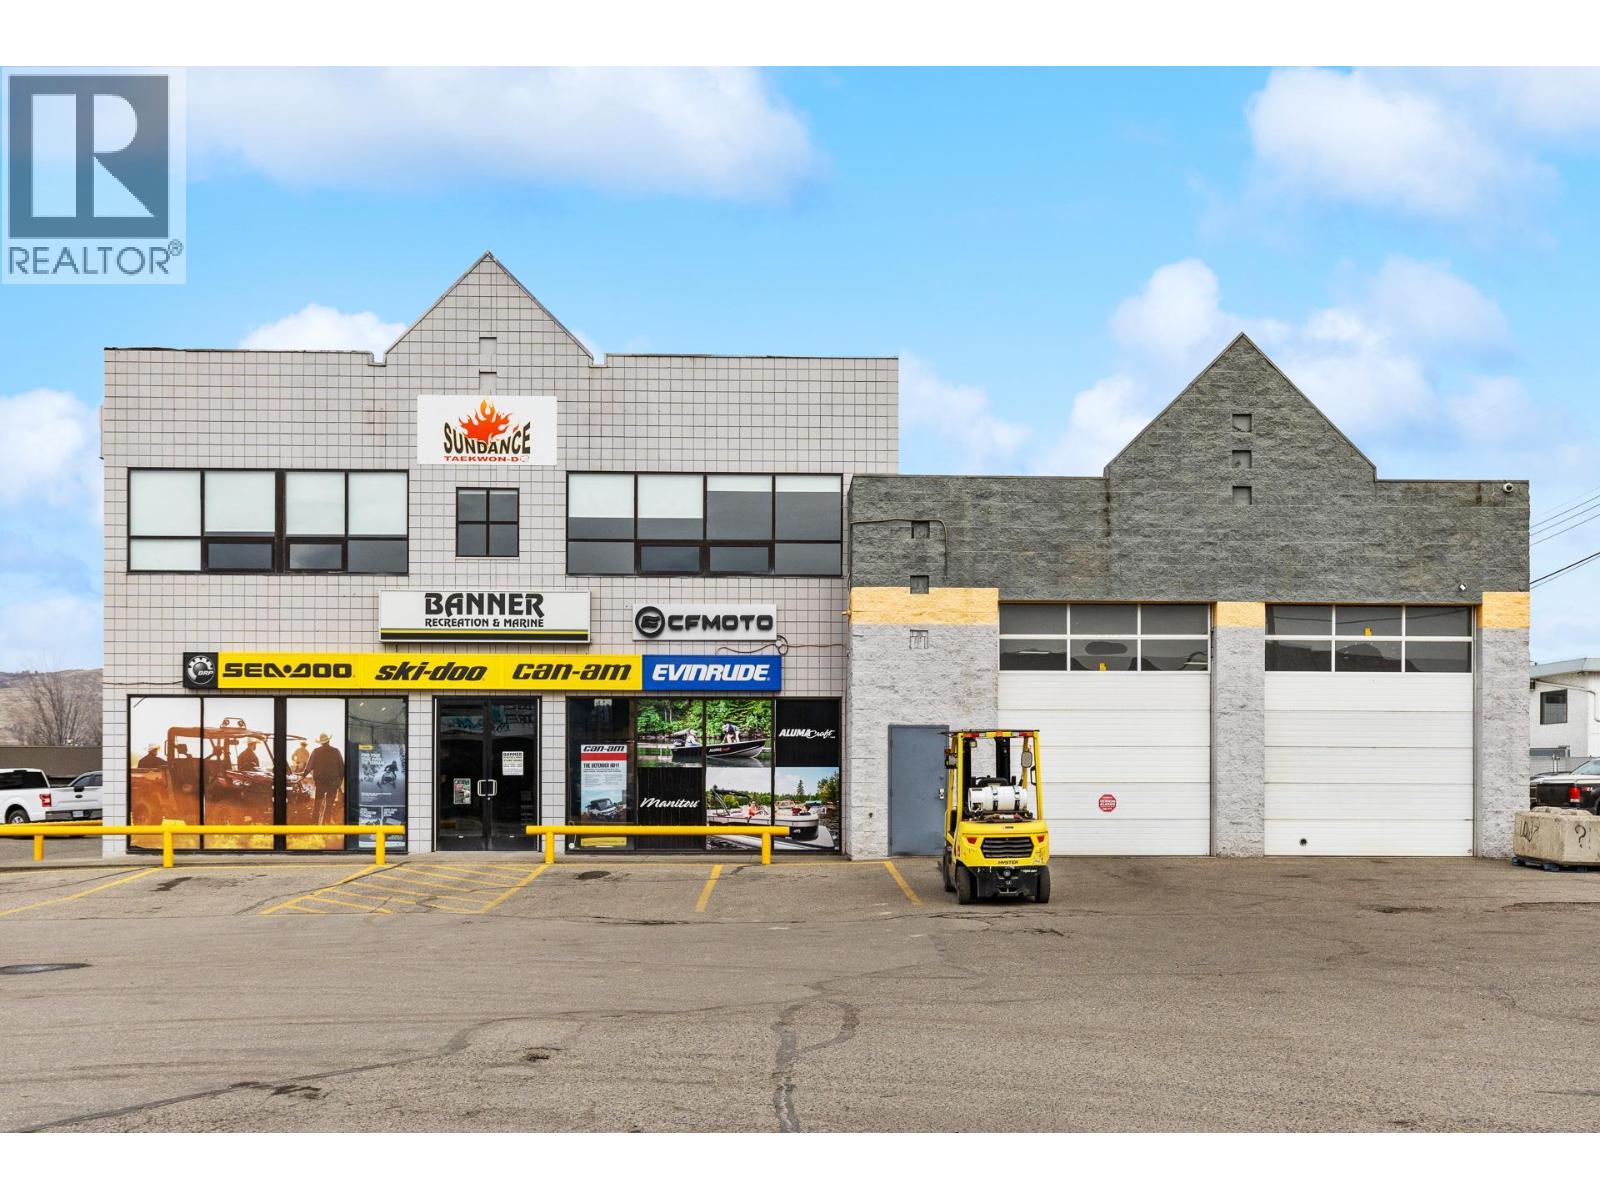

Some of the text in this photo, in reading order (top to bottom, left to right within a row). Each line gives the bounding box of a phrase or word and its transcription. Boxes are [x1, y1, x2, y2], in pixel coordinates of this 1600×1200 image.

[443, 421, 531, 455] SUNDANCE
[424, 592, 545, 618] BANNER
[424, 618, 544, 628] RECREATION & MARINE
[667, 614, 774, 631] CFMOTO
[374, 661, 488, 682] ski-doo
[512, 662, 632, 681] can-am
[652, 663, 771, 682] EVINRUDE
[639, 796, 700, 809] Manitou
